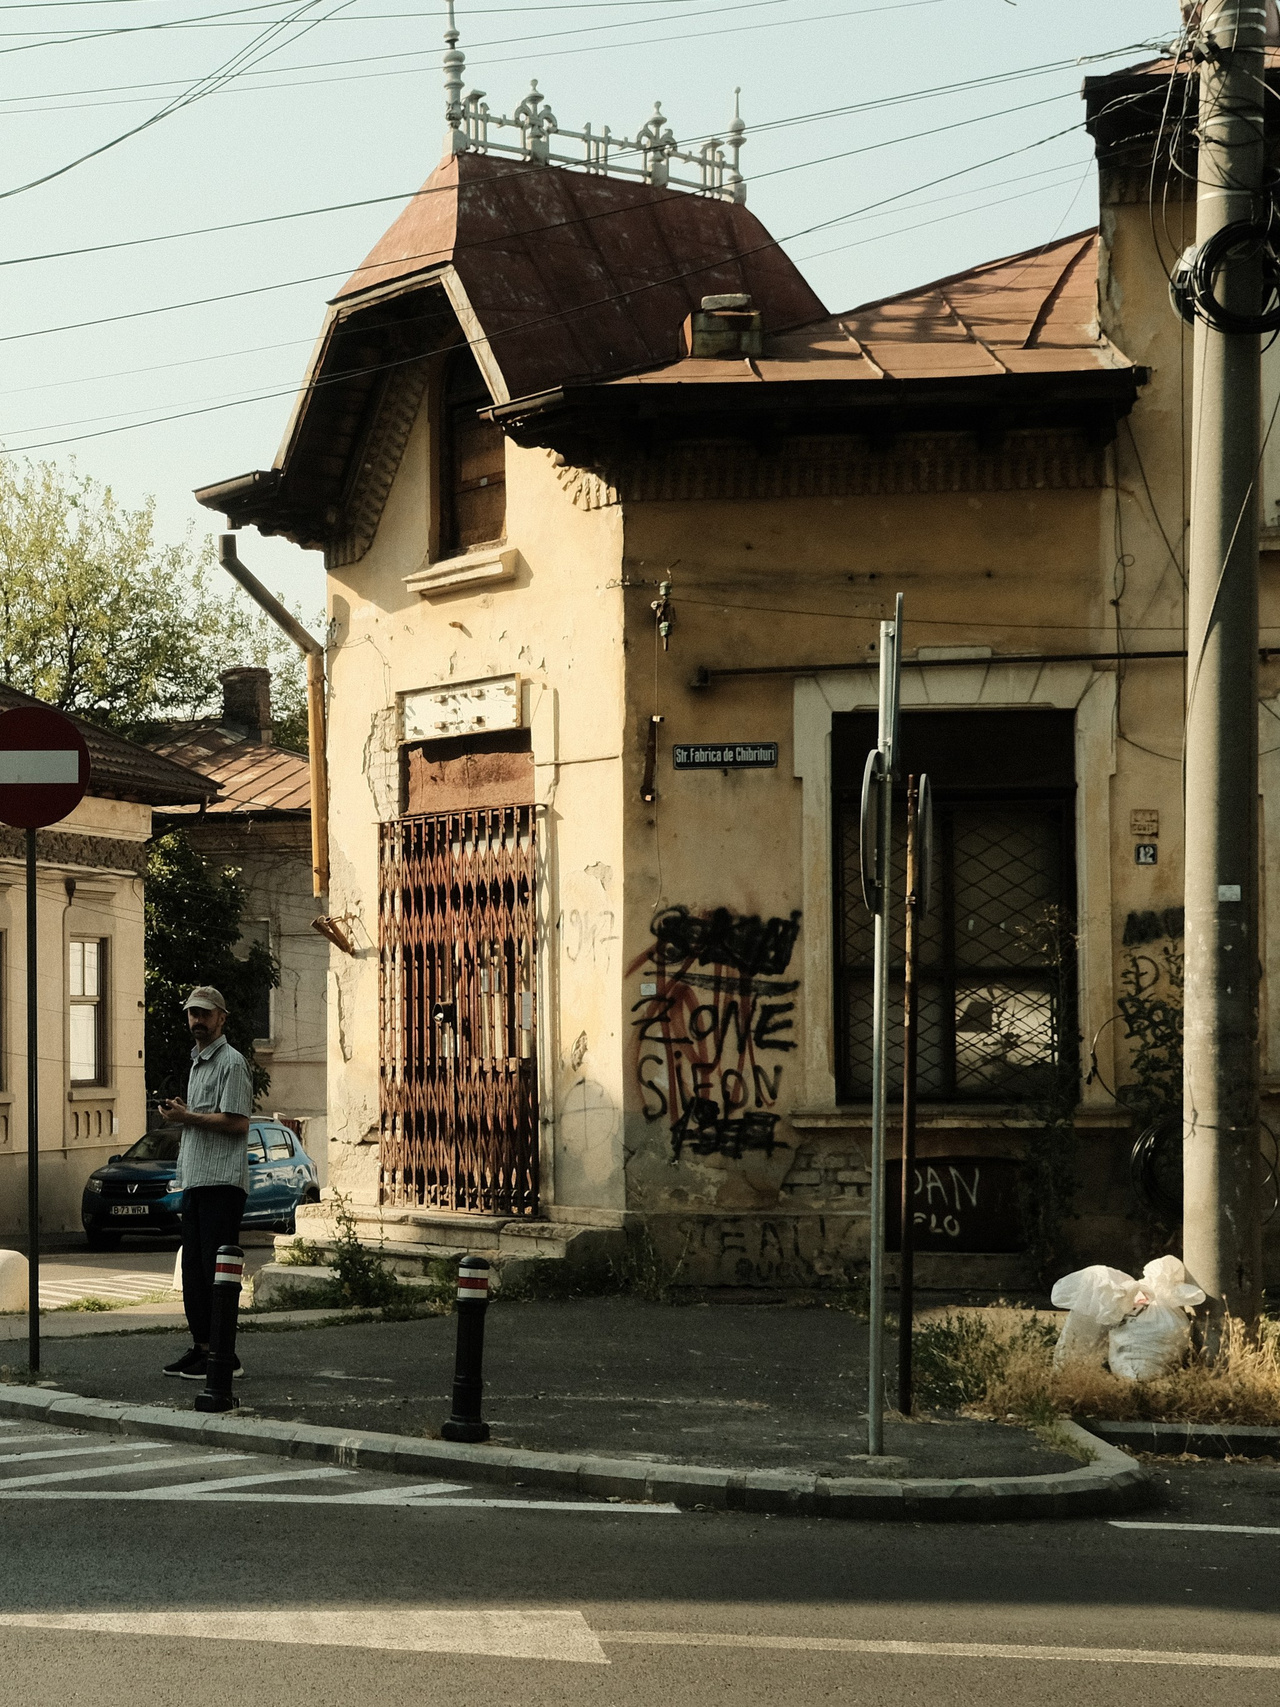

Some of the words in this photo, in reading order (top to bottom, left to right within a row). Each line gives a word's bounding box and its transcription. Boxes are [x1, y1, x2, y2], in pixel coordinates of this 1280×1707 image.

[723, 747, 734, 762] de
[735, 746, 775, 761] Chibrituri
[1138, 846, 1154, 863] 12
[631, 996, 798, 1066] ZONE
